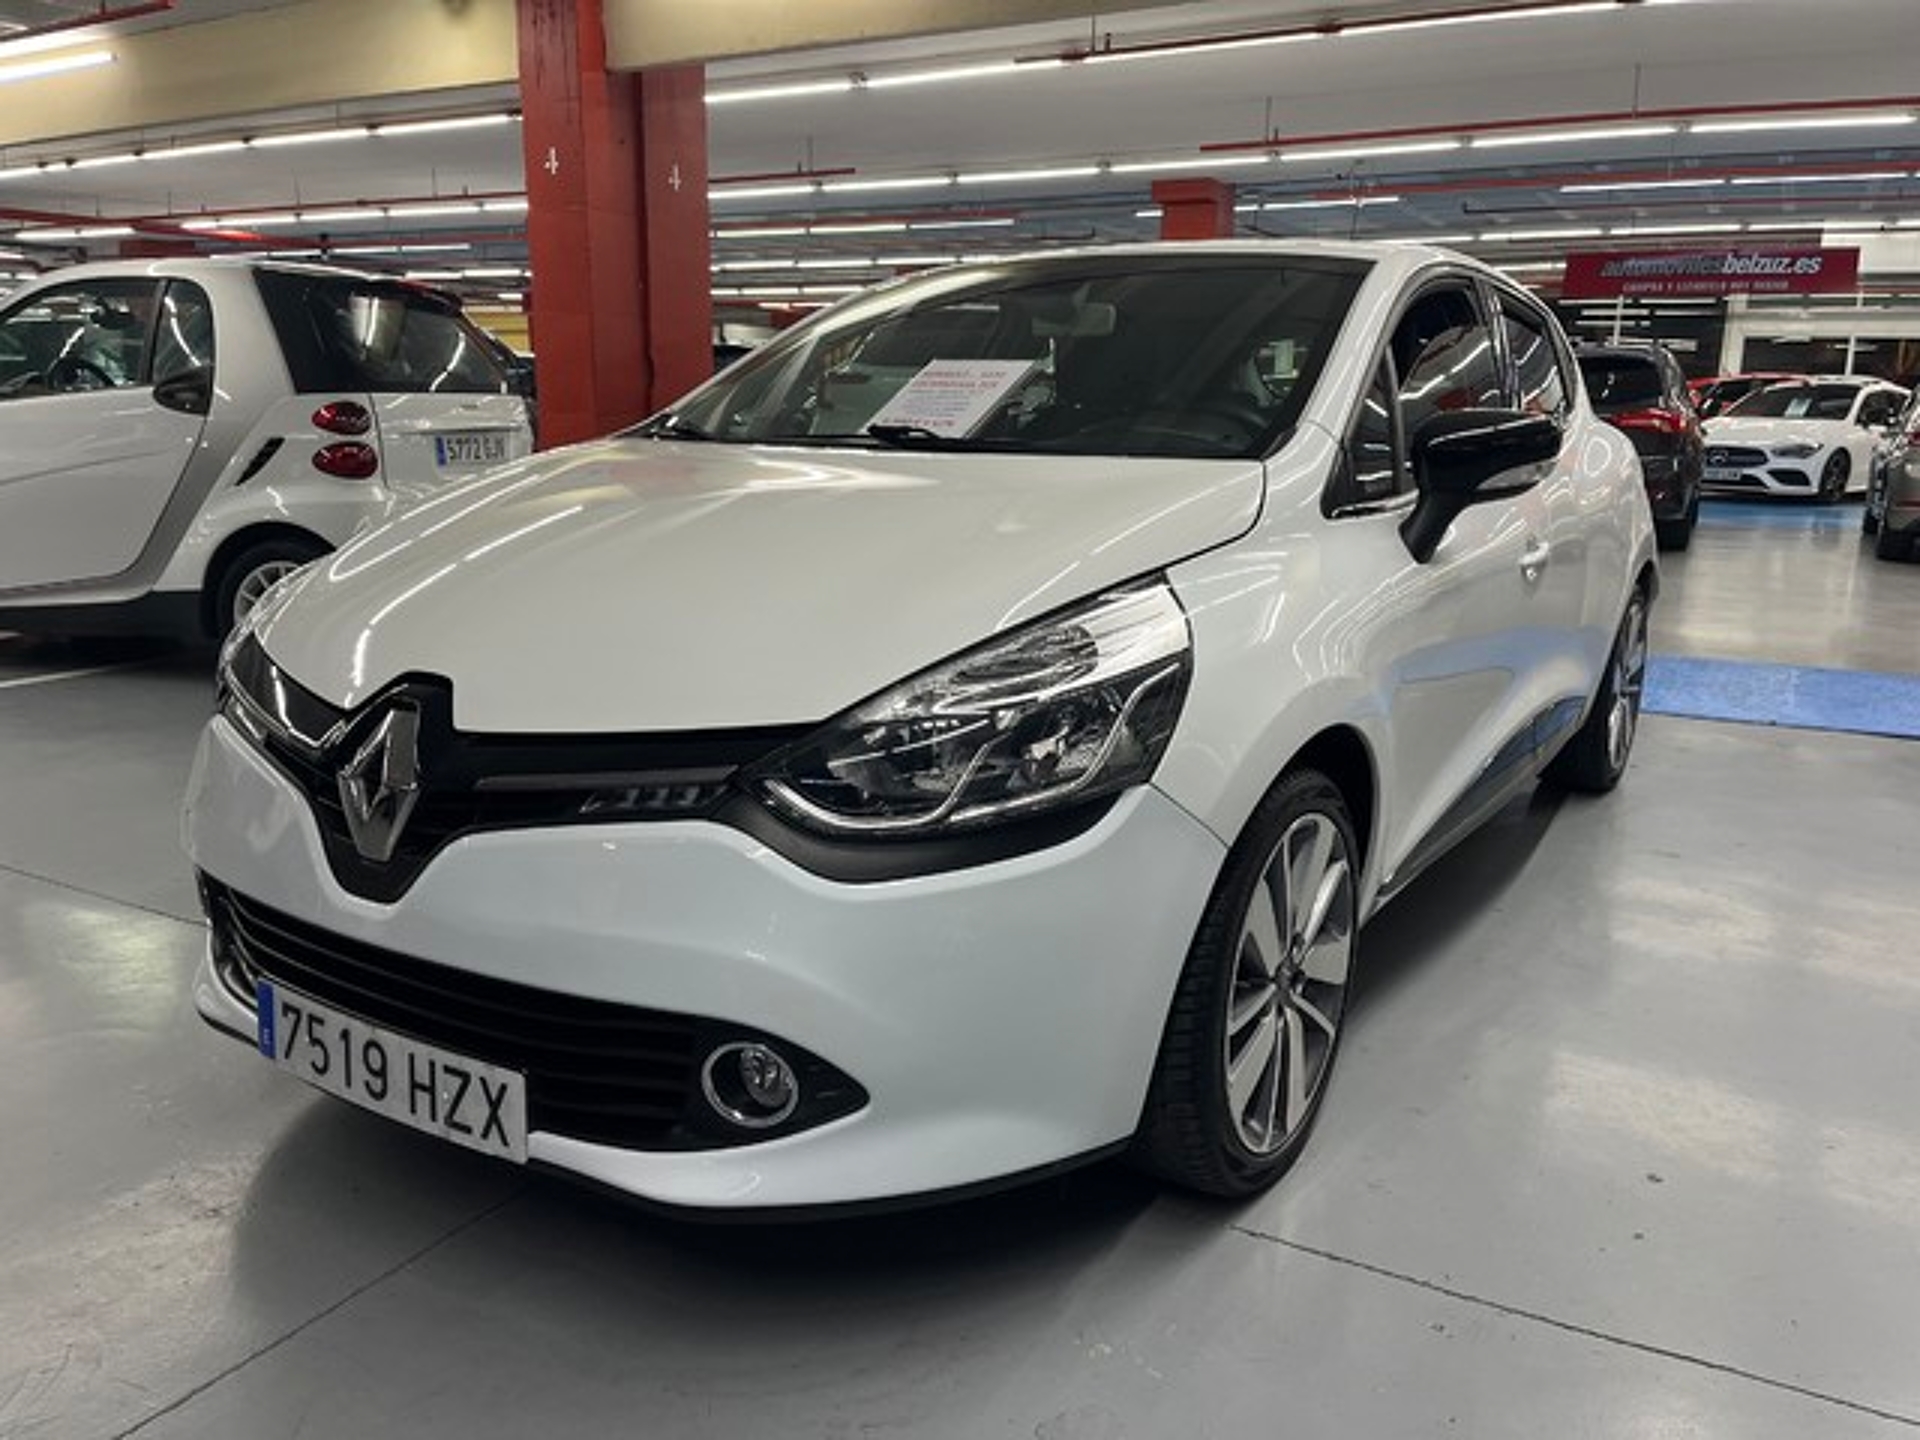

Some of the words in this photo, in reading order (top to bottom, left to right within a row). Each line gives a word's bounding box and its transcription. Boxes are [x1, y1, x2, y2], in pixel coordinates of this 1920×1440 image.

[544, 147, 559, 175] 4
[668, 164, 681, 191] 4
[446, 436, 481, 461] 5772
[281, 1002, 388, 1101] 7519
[408, 1052, 510, 1148] HZX
